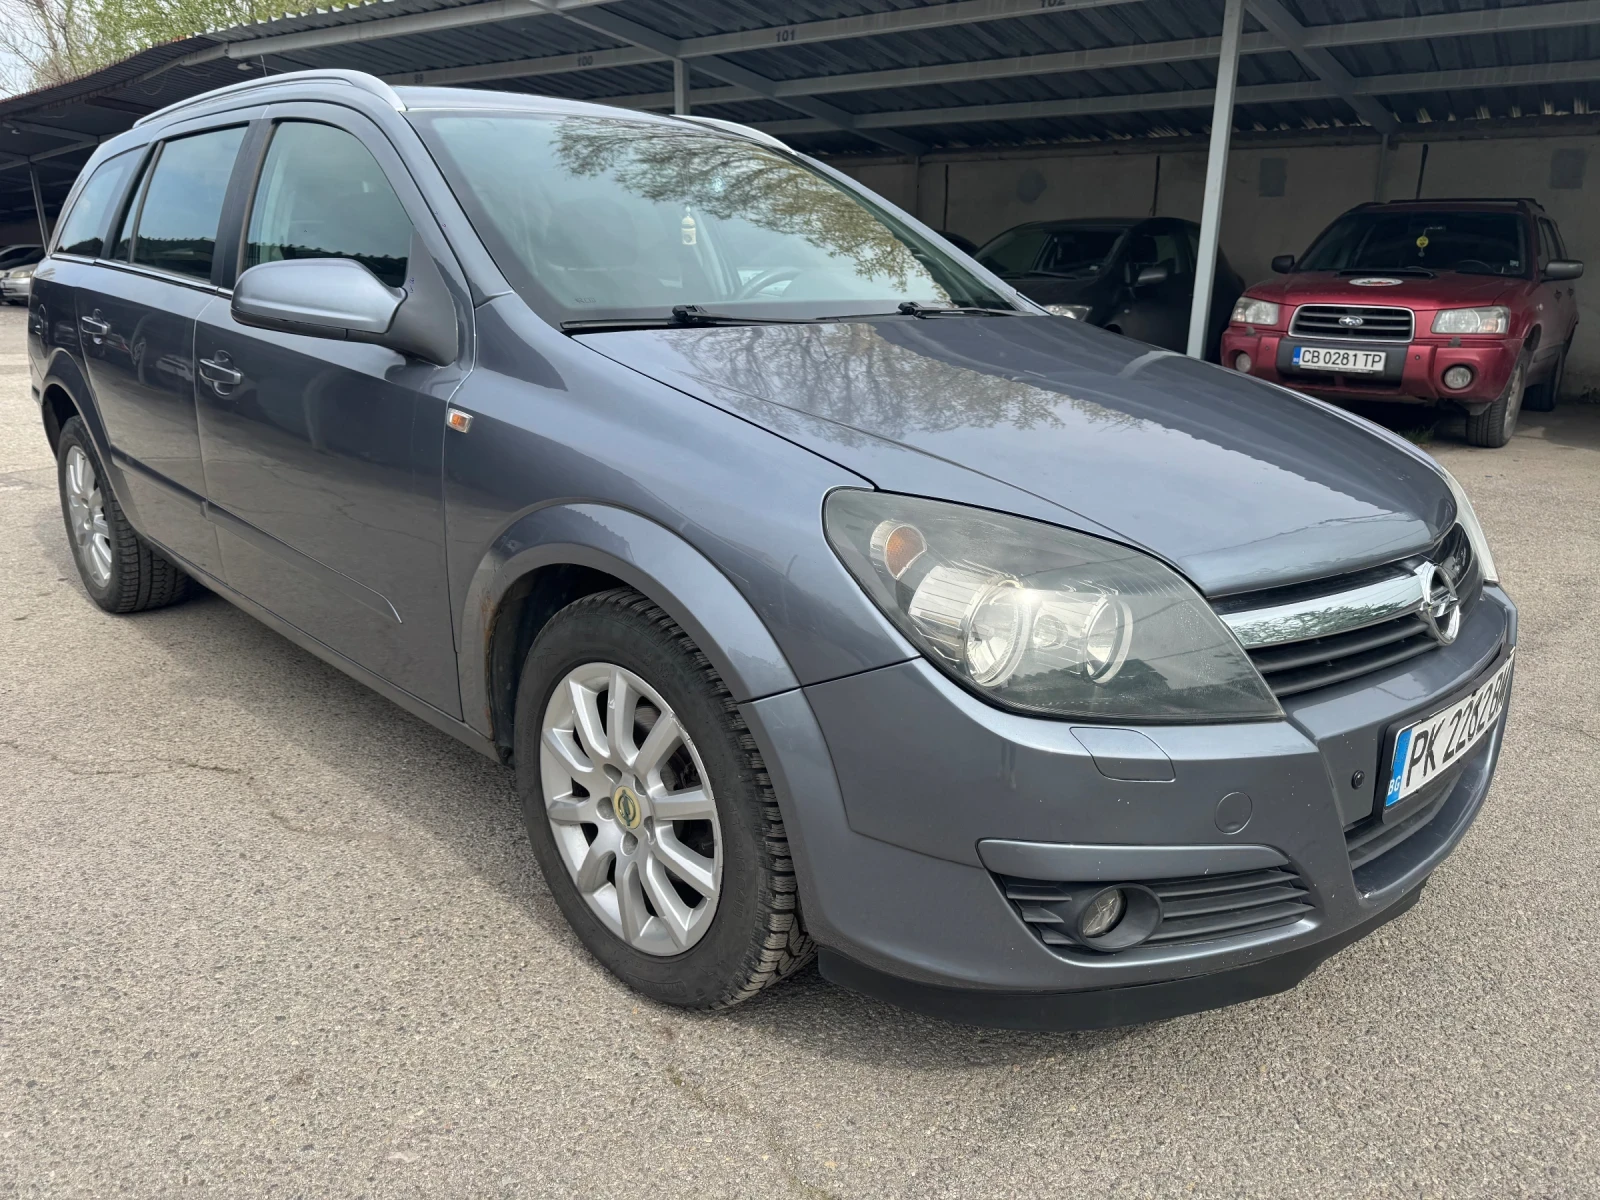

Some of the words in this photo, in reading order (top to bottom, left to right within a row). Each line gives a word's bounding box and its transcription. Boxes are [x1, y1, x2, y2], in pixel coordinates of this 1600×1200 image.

[776, 30, 795, 42] 101
[577, 55, 593, 67] 100
[1302, 350, 1320, 364] CB
[1323, 351, 1358, 367] 0281
[1363, 353, 1382, 368] TP
[1406, 717, 1446, 788] PK
[1388, 775, 1402, 795] BG
